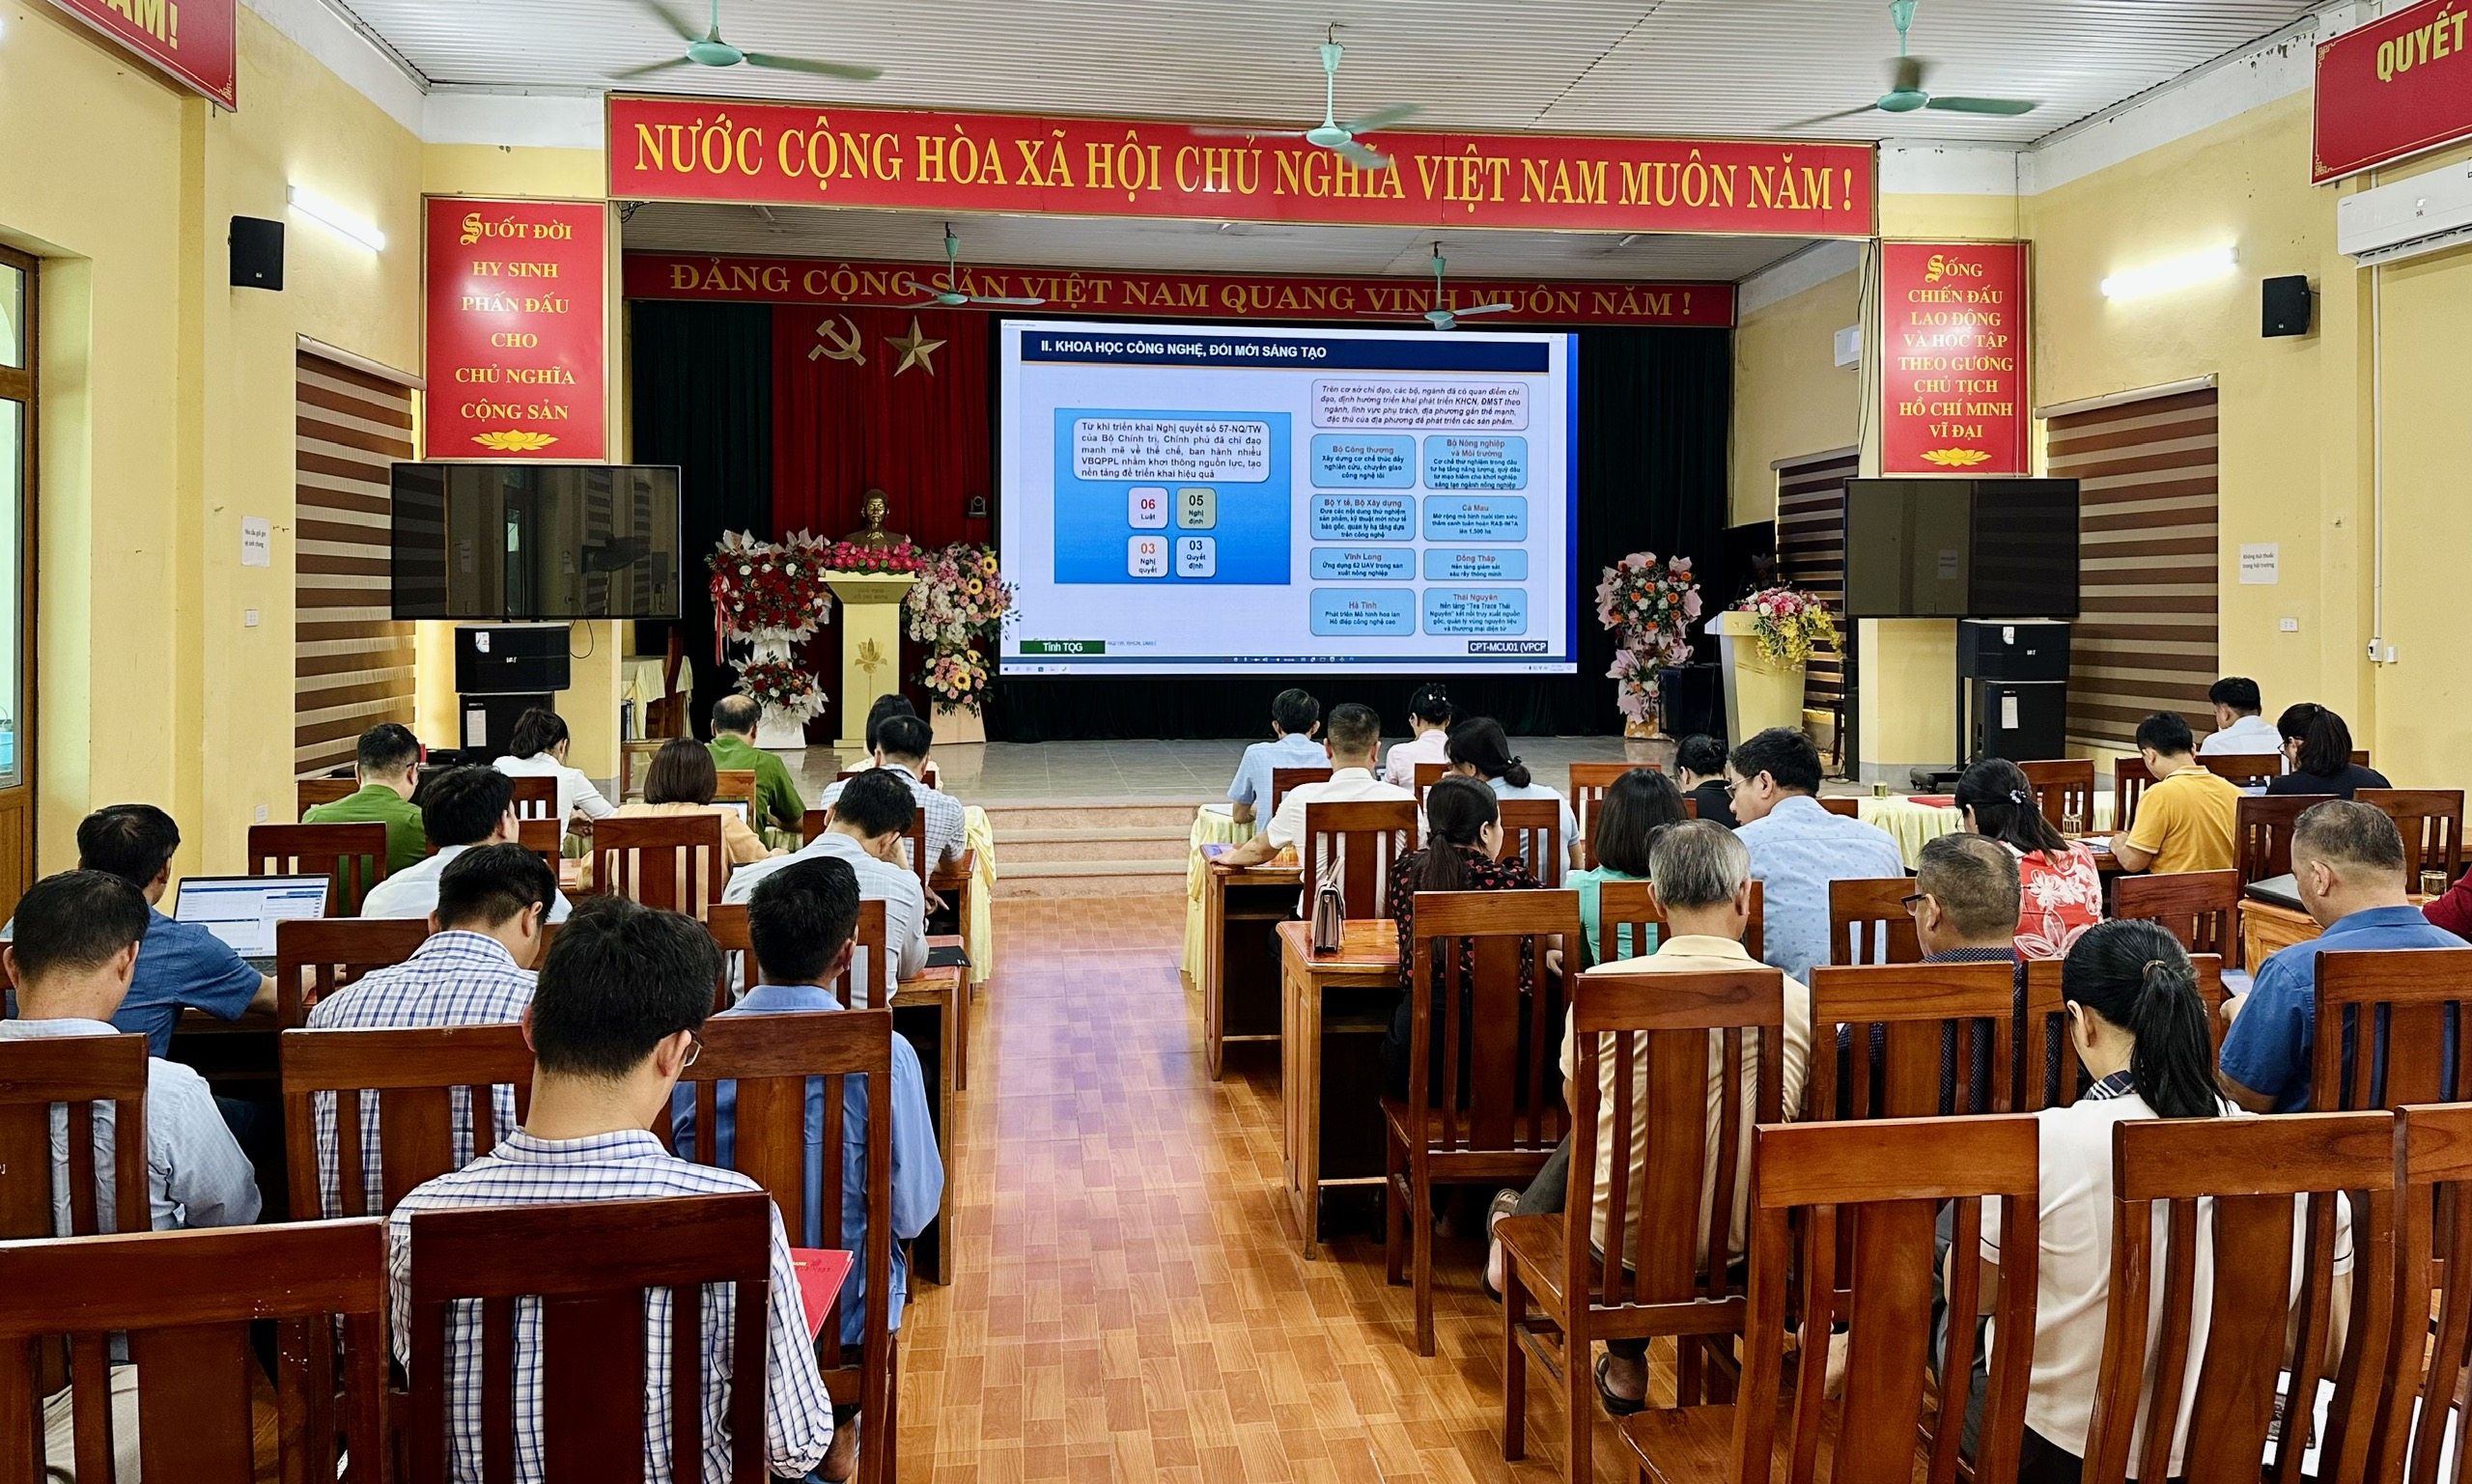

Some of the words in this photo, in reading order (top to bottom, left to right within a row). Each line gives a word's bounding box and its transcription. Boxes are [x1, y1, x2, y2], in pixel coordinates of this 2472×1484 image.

[2376, 2, 2468, 83] QUYẾT
[634, 113, 763, 176] NƯỚC
[778, 115, 903, 191] CỘNG
[915, 123, 1008, 185] HÒA
[1015, 128, 1075, 187] XÃ
[1085, 130, 1162, 203] HỘI
[1175, 134, 1262, 195] CHỦ
[1274, 143, 1405, 199] NGHĨA
[1414, 144, 1510, 213] VIỆT
[1520, 158, 1609, 205] NAM
[1618, 149, 1737, 208] MUÔN
[1747, 153, 1833, 210] NĂM
[1843, 168, 1852, 211] !
[460, 212, 528, 246] SUỐT
[533, 219, 572, 240] ĐỜI
[472, 262, 502, 276] HY
[508, 263, 558, 278] SINH
[1924, 254, 1983, 283] SỐNG
[669, 257, 791, 293] ĐẢNG
[803, 264, 917, 302] CỘNG
[931, 267, 1009, 299] SẢN
[1019, 272, 1112, 309] VIỆT
[1122, 280, 1210, 308] NAM
[1221, 284, 1356, 314] QUANG
[1364, 288, 1456, 313] VINH
[1470, 285, 1581, 314] MUÔN
[1591, 286, 1673, 316] NĂM
[1683, 293, 1691, 315] !
[1908, 284, 1963, 303] CHIẾN
[1967, 285, 2003, 303] ĐẤU
[462, 291, 519, 312] PHẤN
[524, 292, 570, 314] ĐẤU
[1910, 312, 1947, 325] LAO
[1952, 309, 2001, 328] ĐỘNG
[491, 332, 538, 349] CHO
[1903, 330, 1928, 348] VÀ
[1932, 334, 1970, 350] HỌC
[1974, 331, 2008, 350] TẬP
[1041, 341, 1052, 351] II.
[1055, 341, 1093, 352] KHOA
[1096, 342, 1123, 355] HỌC
[1127, 341, 1164, 354] CÔNG
[1167, 343, 1206, 357] NGHỆ,
[1235, 344, 1259, 357] MỚI
[1262, 344, 1298, 357] SÁNG
[1301, 347, 1327, 360] TẠO
[1898, 357, 1947, 371] THEO
[1952, 356, 2013, 372] GƯƠNG
[455, 364, 500, 382] CHỦ
[506, 367, 576, 384] NGHĨA
[1914, 376, 1952, 393] CHỦ
[1955, 380, 1998, 396] TỊCH
[461, 398, 521, 422] CỘNG
[527, 399, 568, 420] SẢN
[1899, 396, 1926, 416] HỒ
[1930, 398, 1961, 416] CHÍ
[1966, 403, 2013, 417] MINH
[1929, 422, 1948, 438] VĨ
[1952, 424, 1982, 440] ĐẠI
[1141, 499, 1155, 510] 06
[1189, 495, 1203, 506] 05
[1141, 543, 1155, 554] 03
[1190, 541, 1202, 550] 03
[1043, 642, 1061, 652] Tỉnh
[1062, 642, 1083, 653] TQG
[1470, 642, 1518, 652] CPT-MCU01
[1520, 642, 1546, 653] (VPCP
